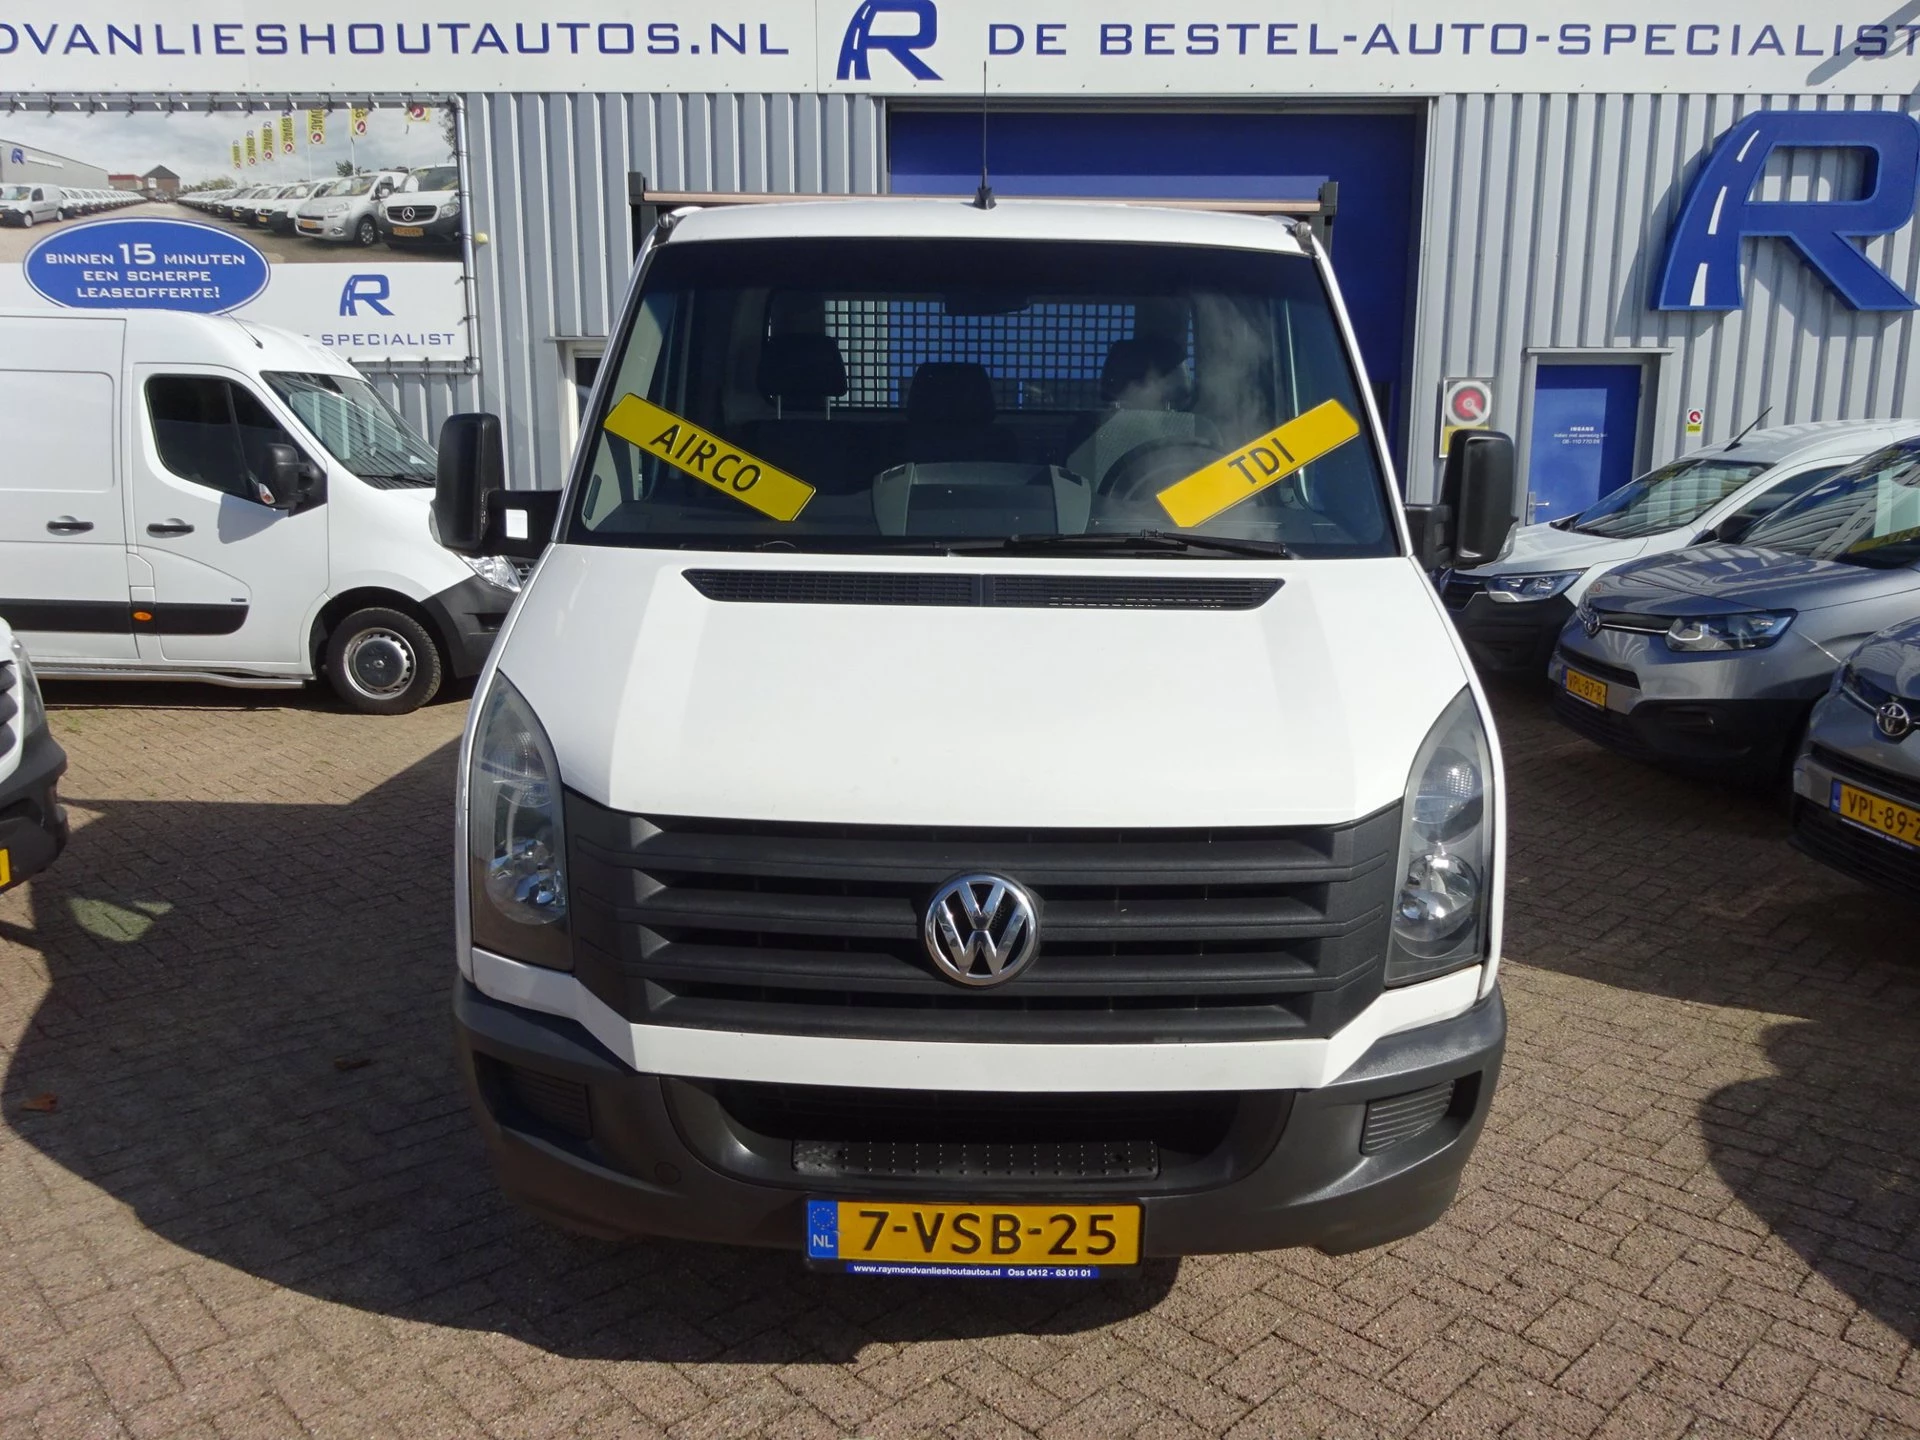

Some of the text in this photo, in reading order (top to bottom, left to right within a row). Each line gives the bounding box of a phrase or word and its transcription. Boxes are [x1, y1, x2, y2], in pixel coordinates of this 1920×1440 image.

[988, 23, 1920, 56] DE BESTEL-AUTO-SPECIALIST
[45, 243, 245, 265] BINNEN 15 MINUTEN
[83, 270, 211, 282] EEN SCHERPE
[76, 286, 220, 299] LEASEOFFERTE!
[321, 333, 455, 346] SPECIALIST
[648, 423, 761, 493] AIRCO
[1227, 437, 1296, 485] TDI
[813, 1210, 1117, 1257] NL 7-VSB-25
[853, 1264, 1001, 1277] www.raymondvanlieshoutautos.nl
[1007, 1268, 1025, 1277] Oss
[1027, 1268, 1048, 1277] 0412
[1055, 1269, 1068, 1278] 63
[1069, 1269, 1079, 1278] 01
[1080, 1269, 1091, 1278] 01
